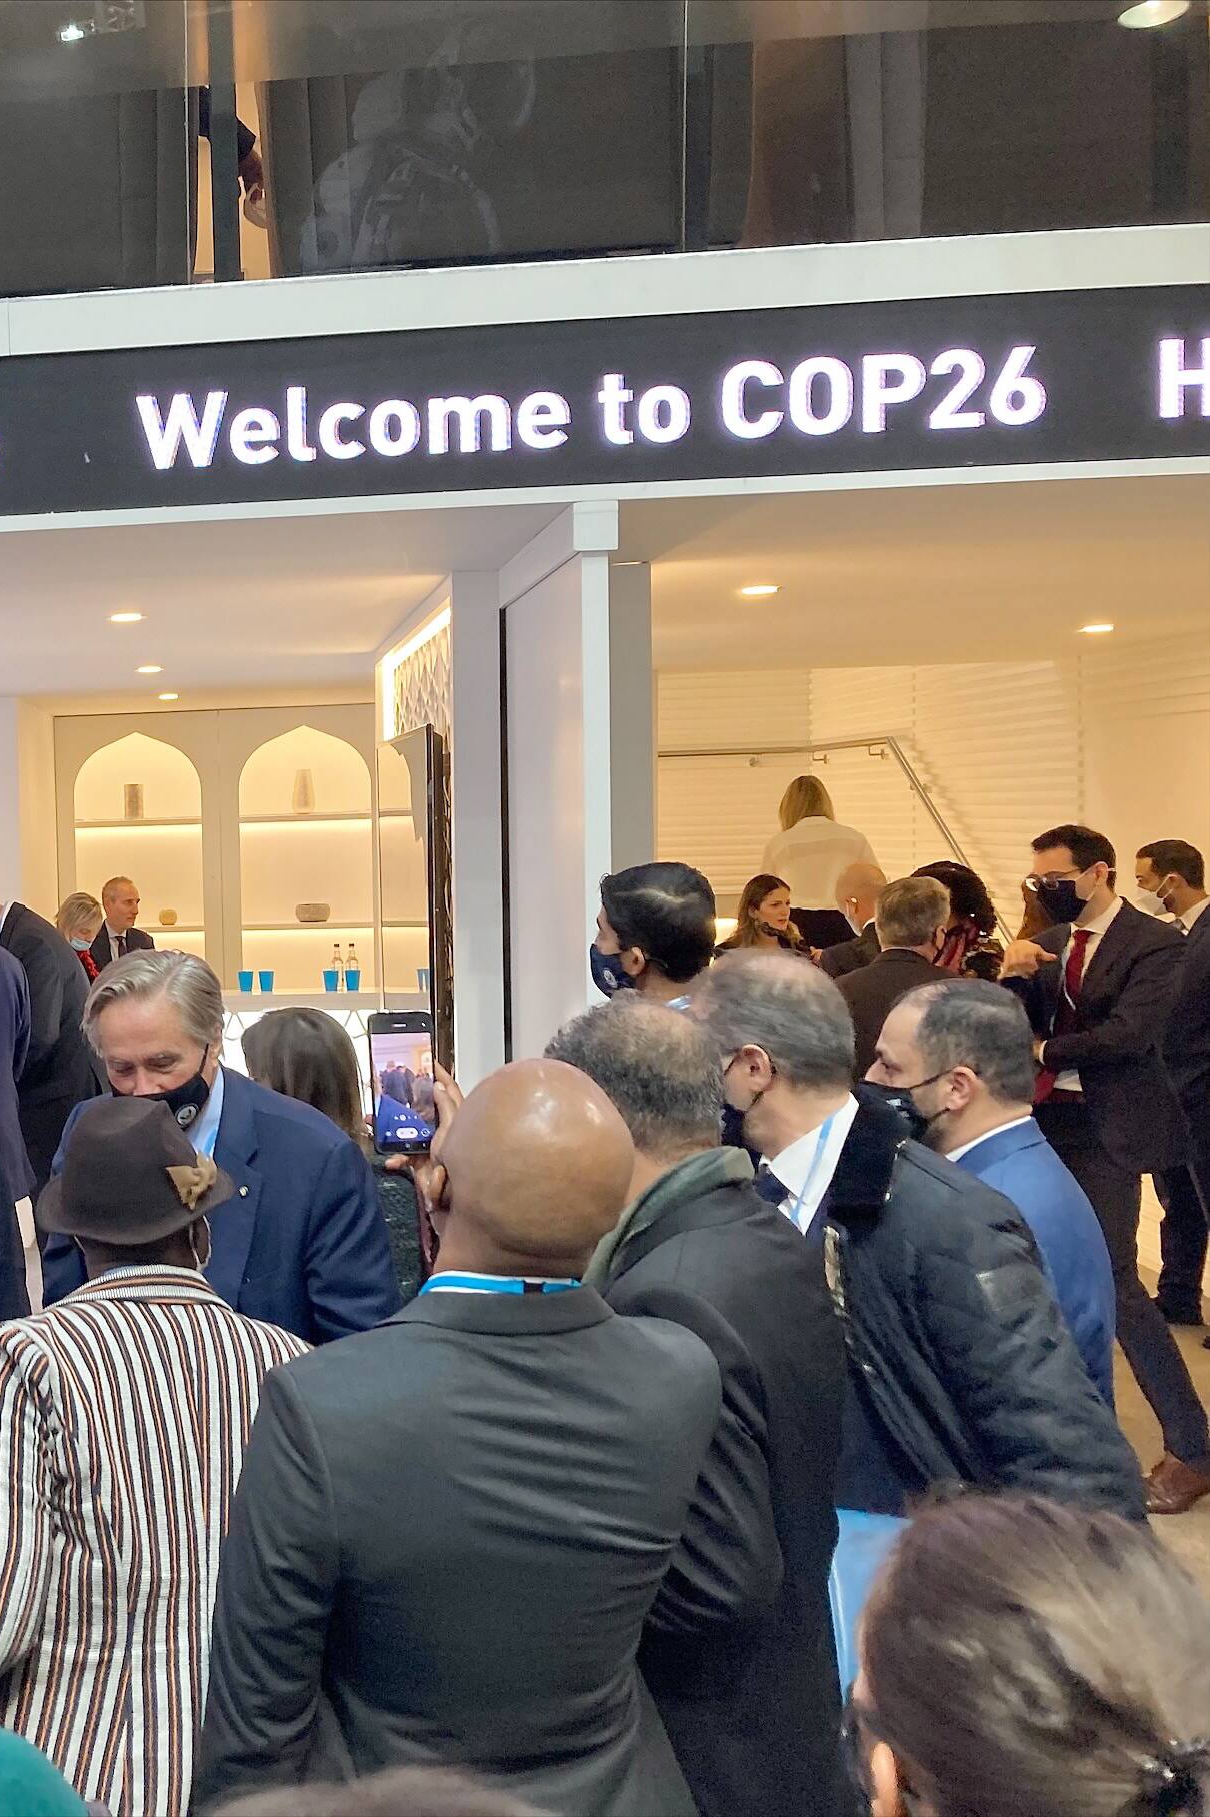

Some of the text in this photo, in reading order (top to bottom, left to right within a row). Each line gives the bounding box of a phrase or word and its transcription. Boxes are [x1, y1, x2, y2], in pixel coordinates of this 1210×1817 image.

[135, 386, 573, 471] Welcome
[597, 373, 691, 446] to
[721, 345, 1047, 440] COP26
